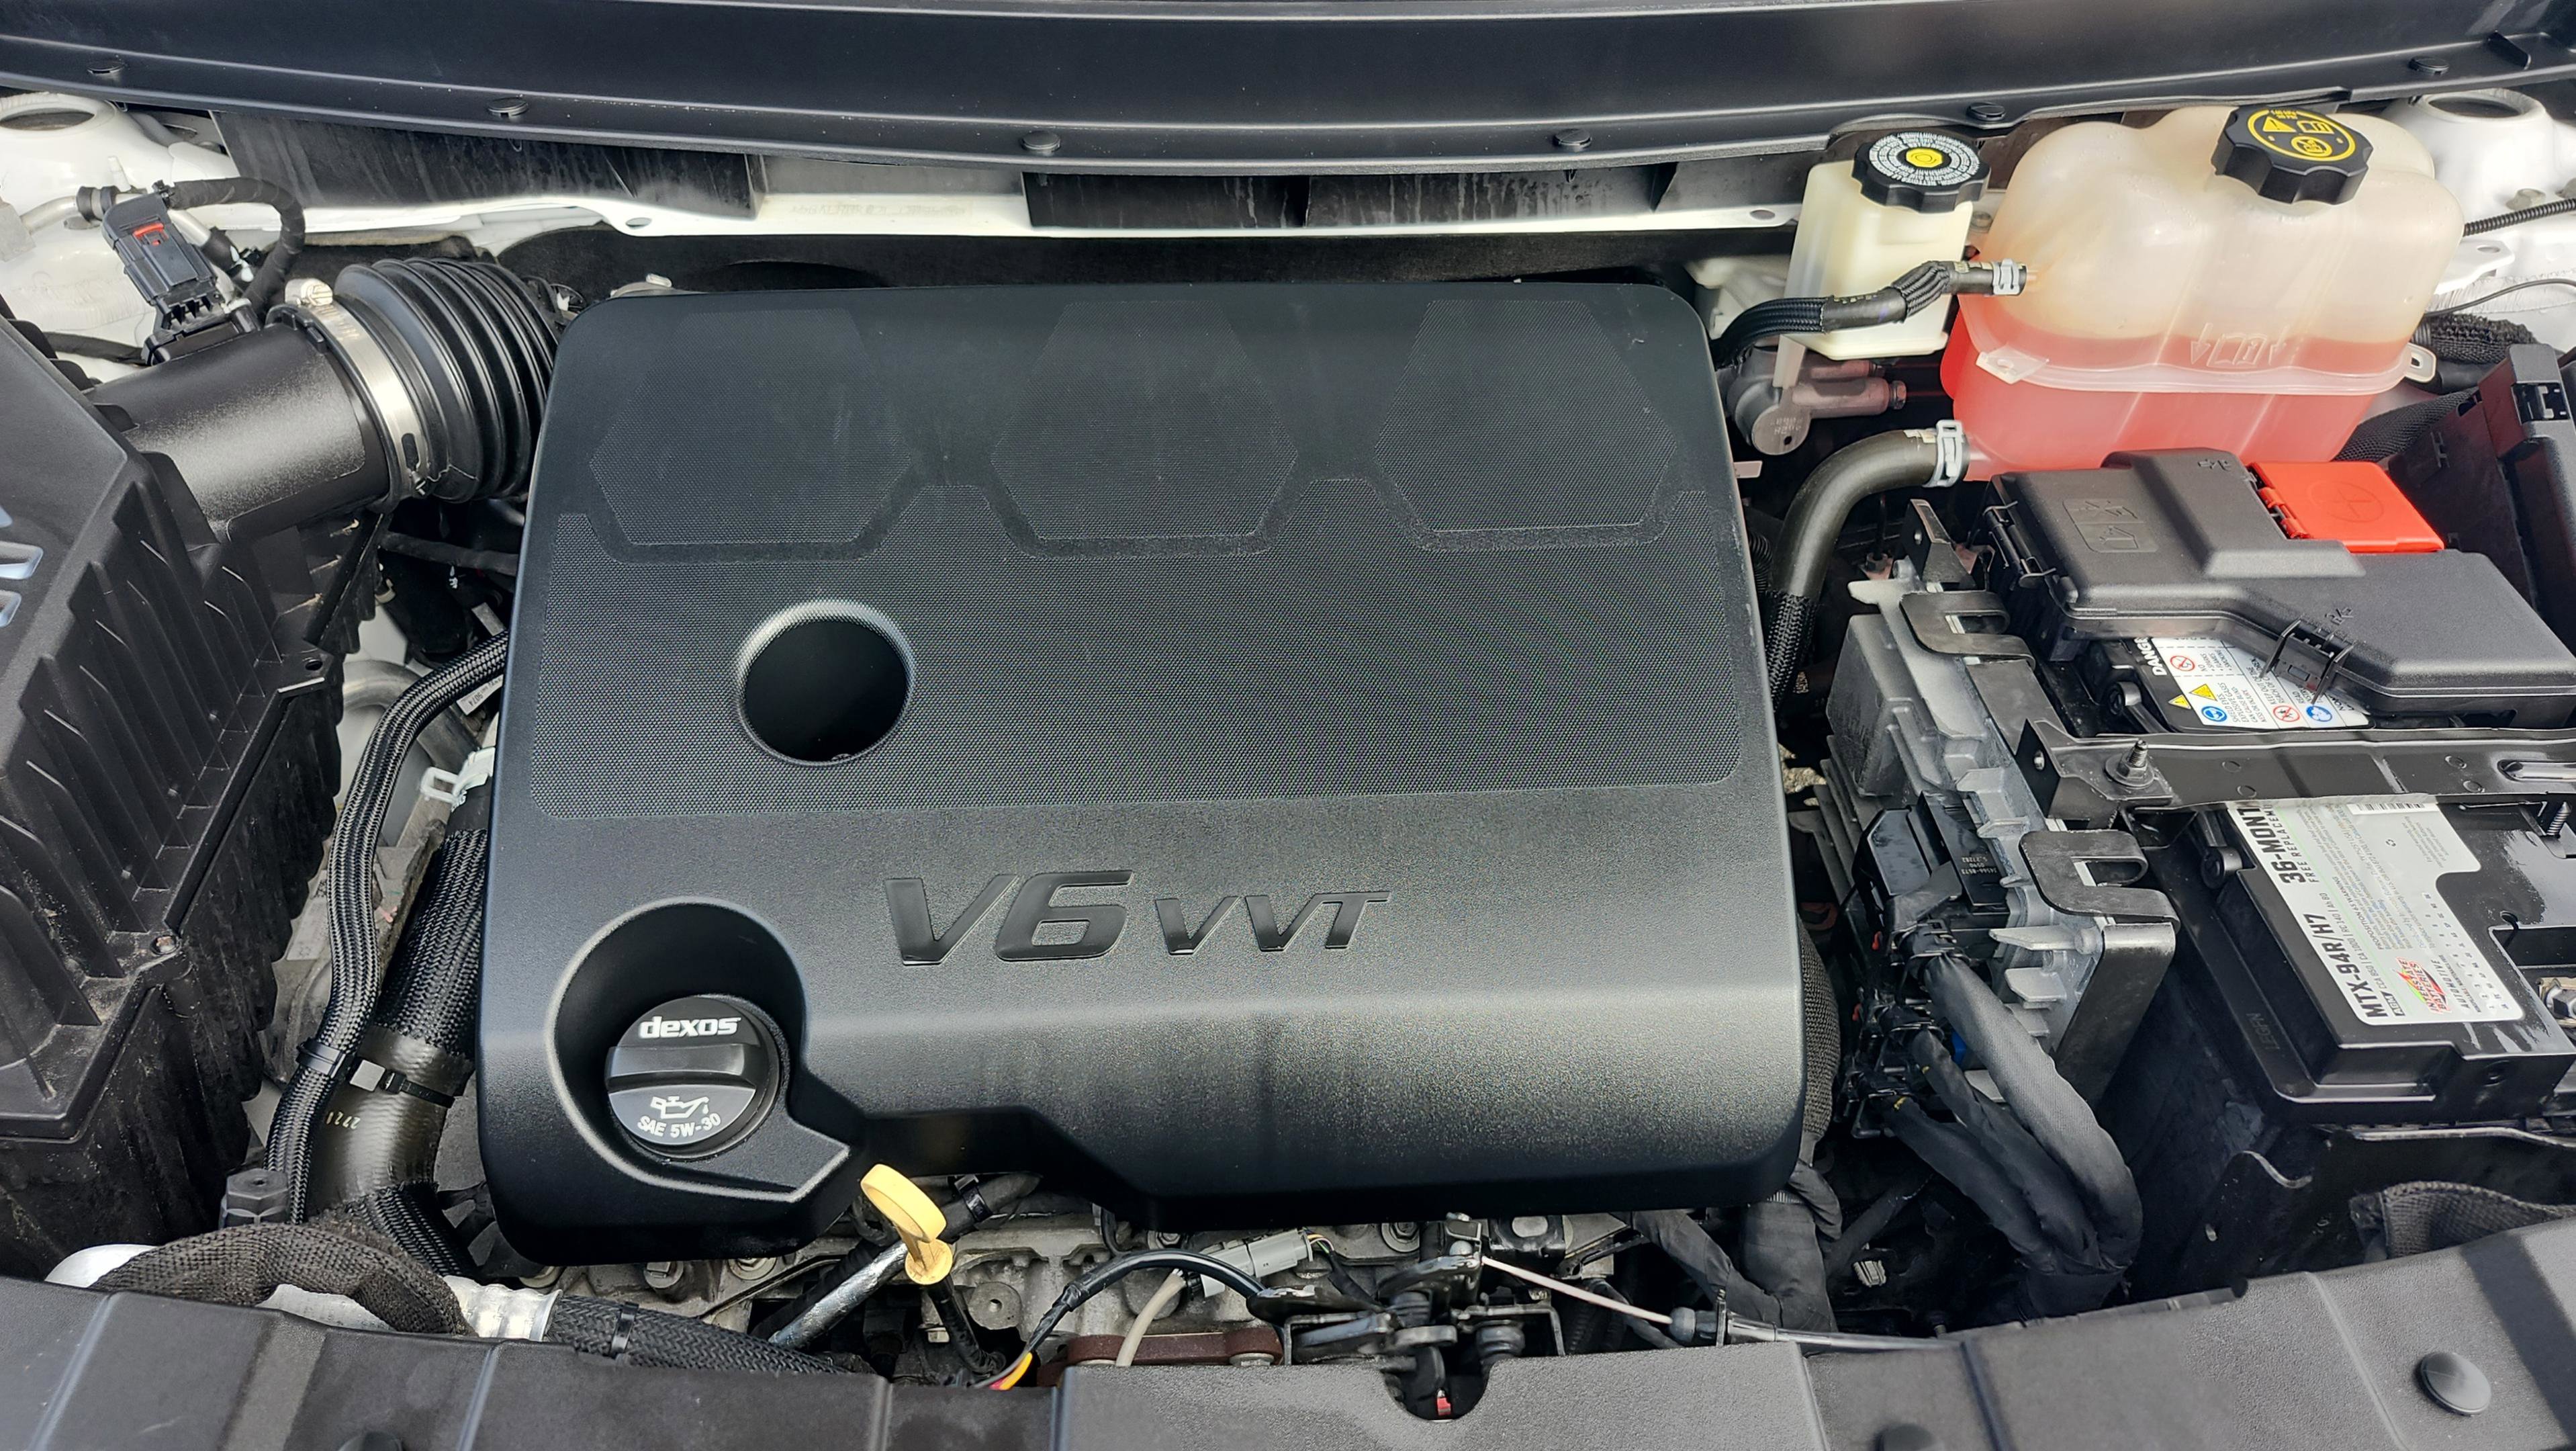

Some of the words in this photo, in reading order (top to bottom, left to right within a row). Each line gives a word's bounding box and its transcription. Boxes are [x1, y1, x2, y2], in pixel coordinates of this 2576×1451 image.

[2217, 683, 2233, 697] GASES
[2227, 697, 2250, 721] EXPLOSIVE
[2237, 808, 2305, 883] 36-MONT
[2297, 861, 2319, 883] FREE
[2331, 877, 2354, 902] WARNING
[885, 871, 1134, 966] V6
[1155, 891, 1391, 955] VVT
[2356, 912, 2384, 950] PROPOSITION
[2303, 914, 2388, 1017] MTX-94R/H7
[2374, 978, 2387, 988] CCA
[2399, 959, 2439, 1011] INTERSTATE
[2410, 962, 2447, 1010] BATTERIES
[2432, 959, 2470, 1009] AUTOMOTIVE
[2385, 994, 2403, 1015] AGM
[639, 1016, 741, 1039] dexos
[637, 1116, 667, 1137] SAE
[670, 1112, 721, 1138] 5W-30
